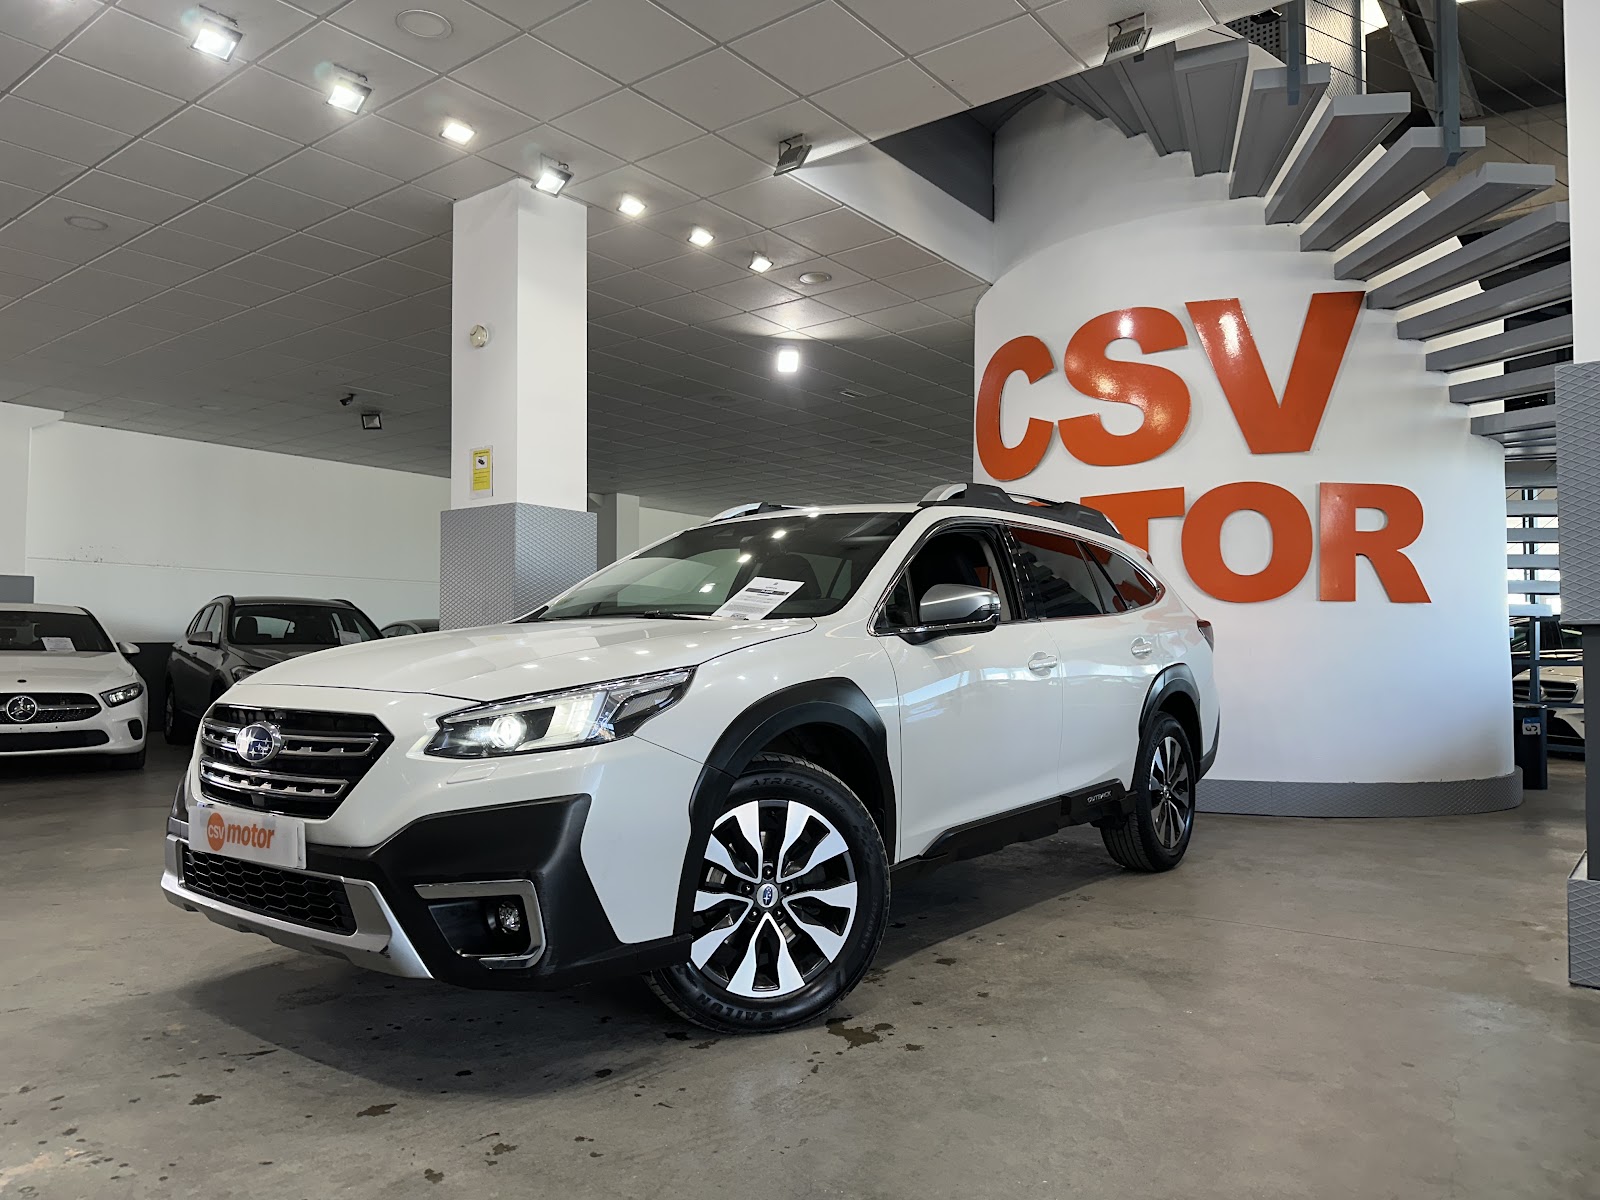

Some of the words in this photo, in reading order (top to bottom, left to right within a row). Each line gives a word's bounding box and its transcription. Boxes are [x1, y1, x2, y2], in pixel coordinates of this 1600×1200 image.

[976, 291, 1366, 481] CSV
[749, 777, 824, 795] ATREZZO
[1087, 790, 1112, 803] OUTBACK
[208, 825, 225, 840] CSV
[226, 823, 275, 849] motor
[696, 994, 773, 1021] SAILUN
